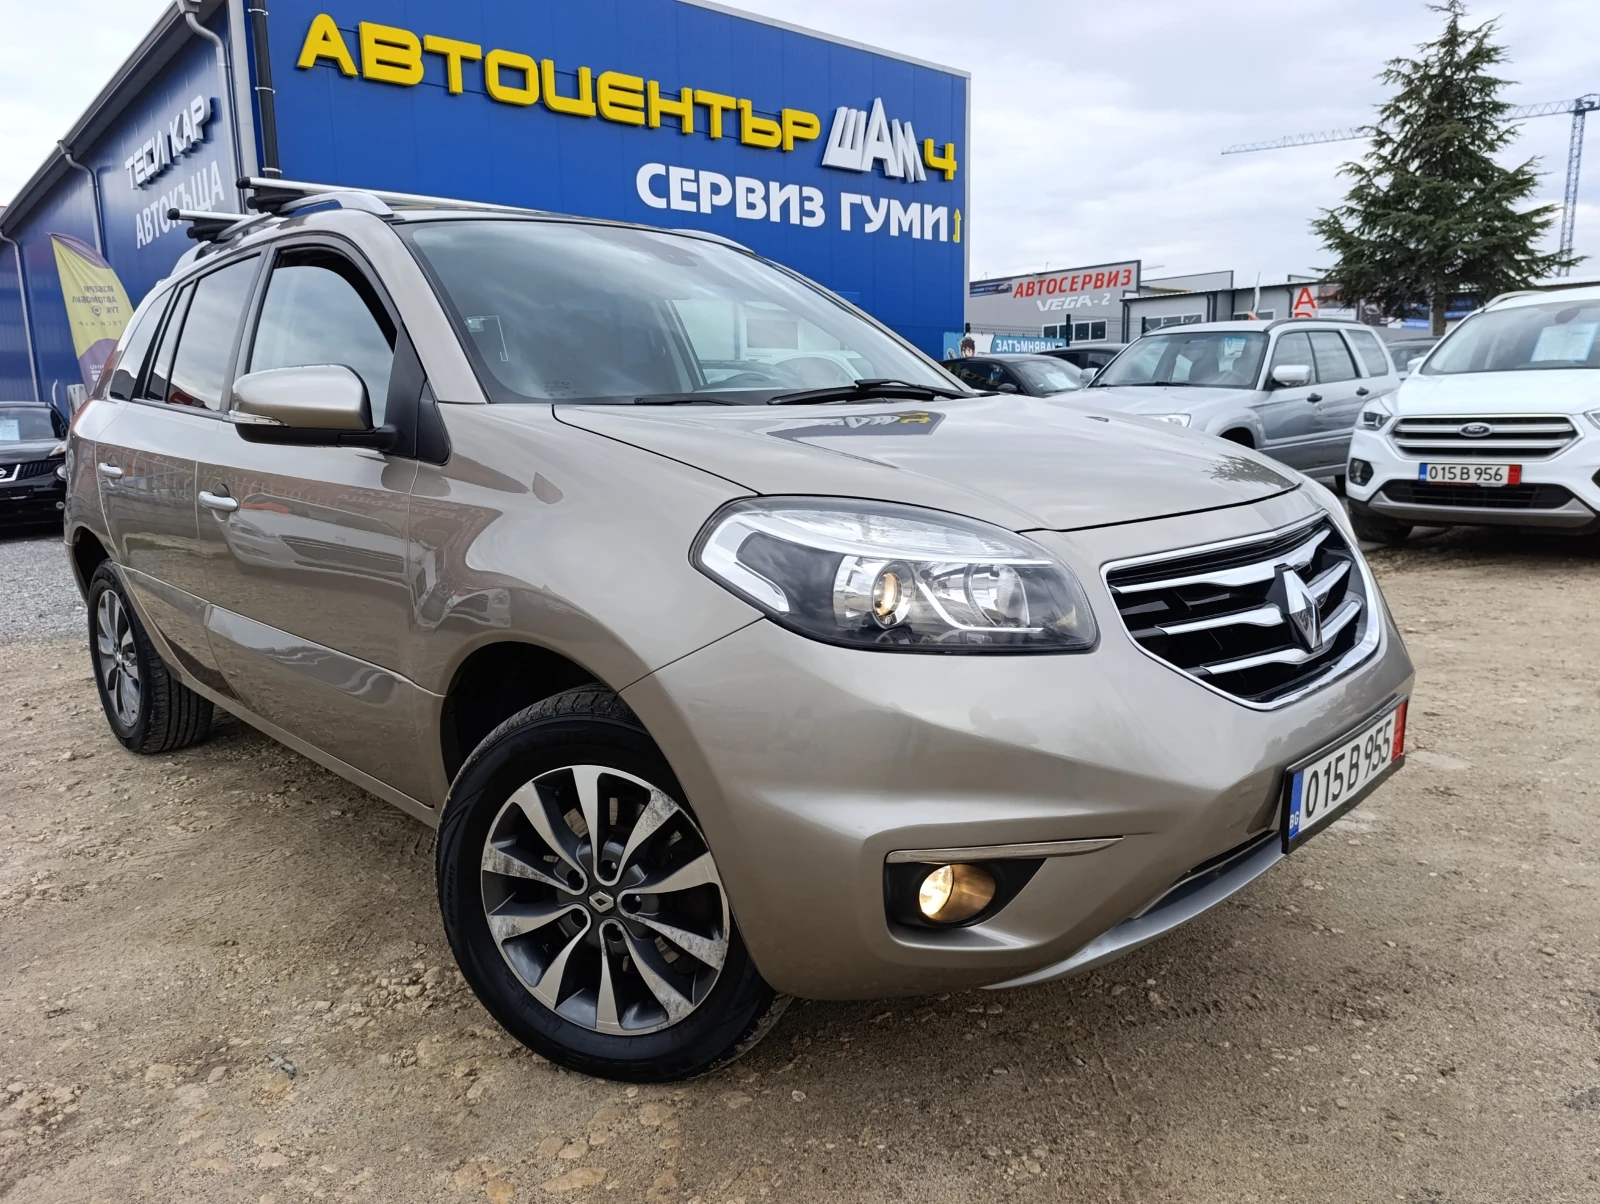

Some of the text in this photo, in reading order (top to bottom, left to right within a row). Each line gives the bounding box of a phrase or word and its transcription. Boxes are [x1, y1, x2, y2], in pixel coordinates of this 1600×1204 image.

[297, 13, 820, 152] АВТОЦЕНТЪР
[822, 97, 927, 184] ШАМ
[125, 94, 211, 190] ТЕСИ КАР
[136, 160, 225, 249] АВТОКЪЩА
[635, 162, 948, 242] СЕРВИЗ ГУМИ
[1013, 269, 1132, 299] АВТОСЕРВИЗ
[996, 339, 1064, 353] ЗАТЪМНЯВА
[1289, 811, 1299, 828] BG
